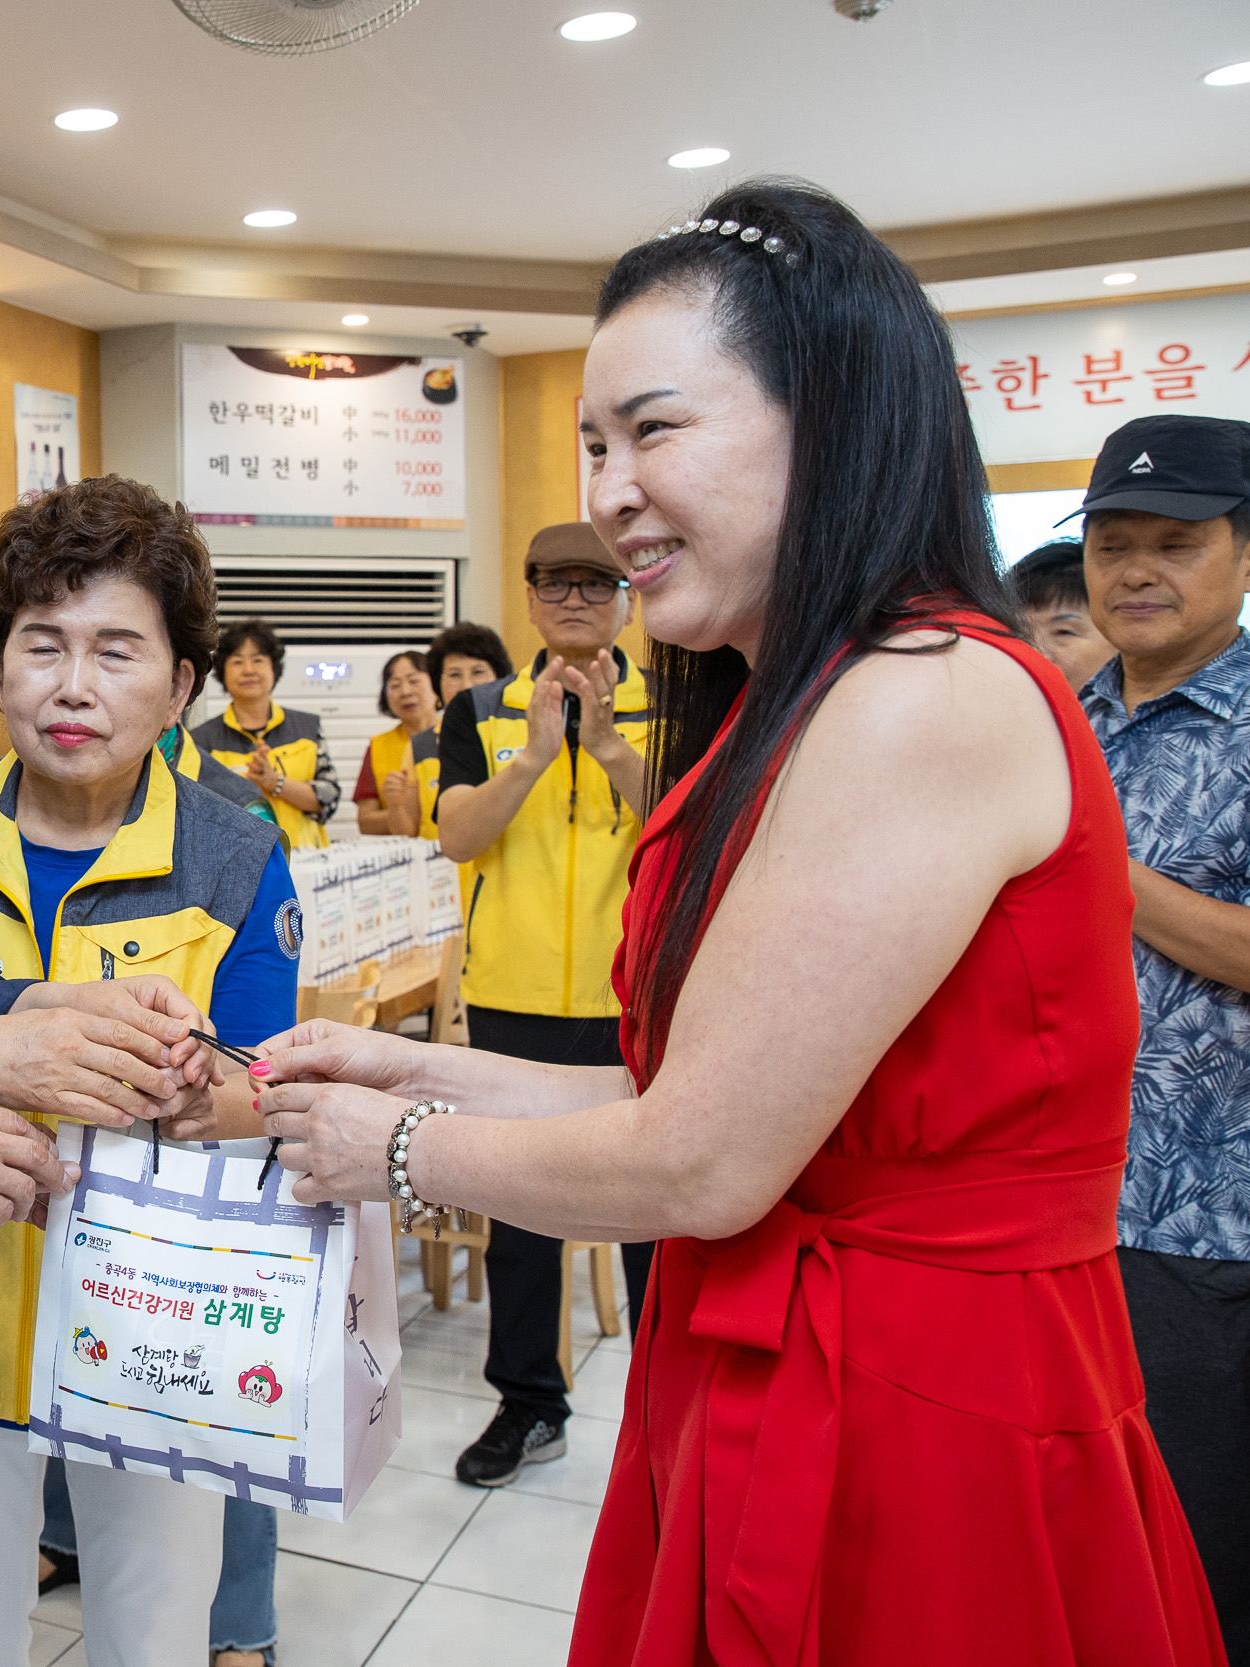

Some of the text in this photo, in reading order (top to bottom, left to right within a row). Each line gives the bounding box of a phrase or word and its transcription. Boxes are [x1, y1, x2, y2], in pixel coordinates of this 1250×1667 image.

[1073, 343, 1206, 405] 분을
[209, 401, 319, 427] 한우떡갈비
[394, 408, 442, 424] 16,000
[394, 428, 442, 445] 11,000
[394, 461, 442, 476] 10,000
[402, 481, 443, 497] 7,000
[89, 1235, 111, 1247] 광진구
[105, 1262, 267, 1301] 중곡4동 지역사회보장협의체와 함께하는
[82, 1279, 285, 1334] 어르신건강기원 삼계탕
